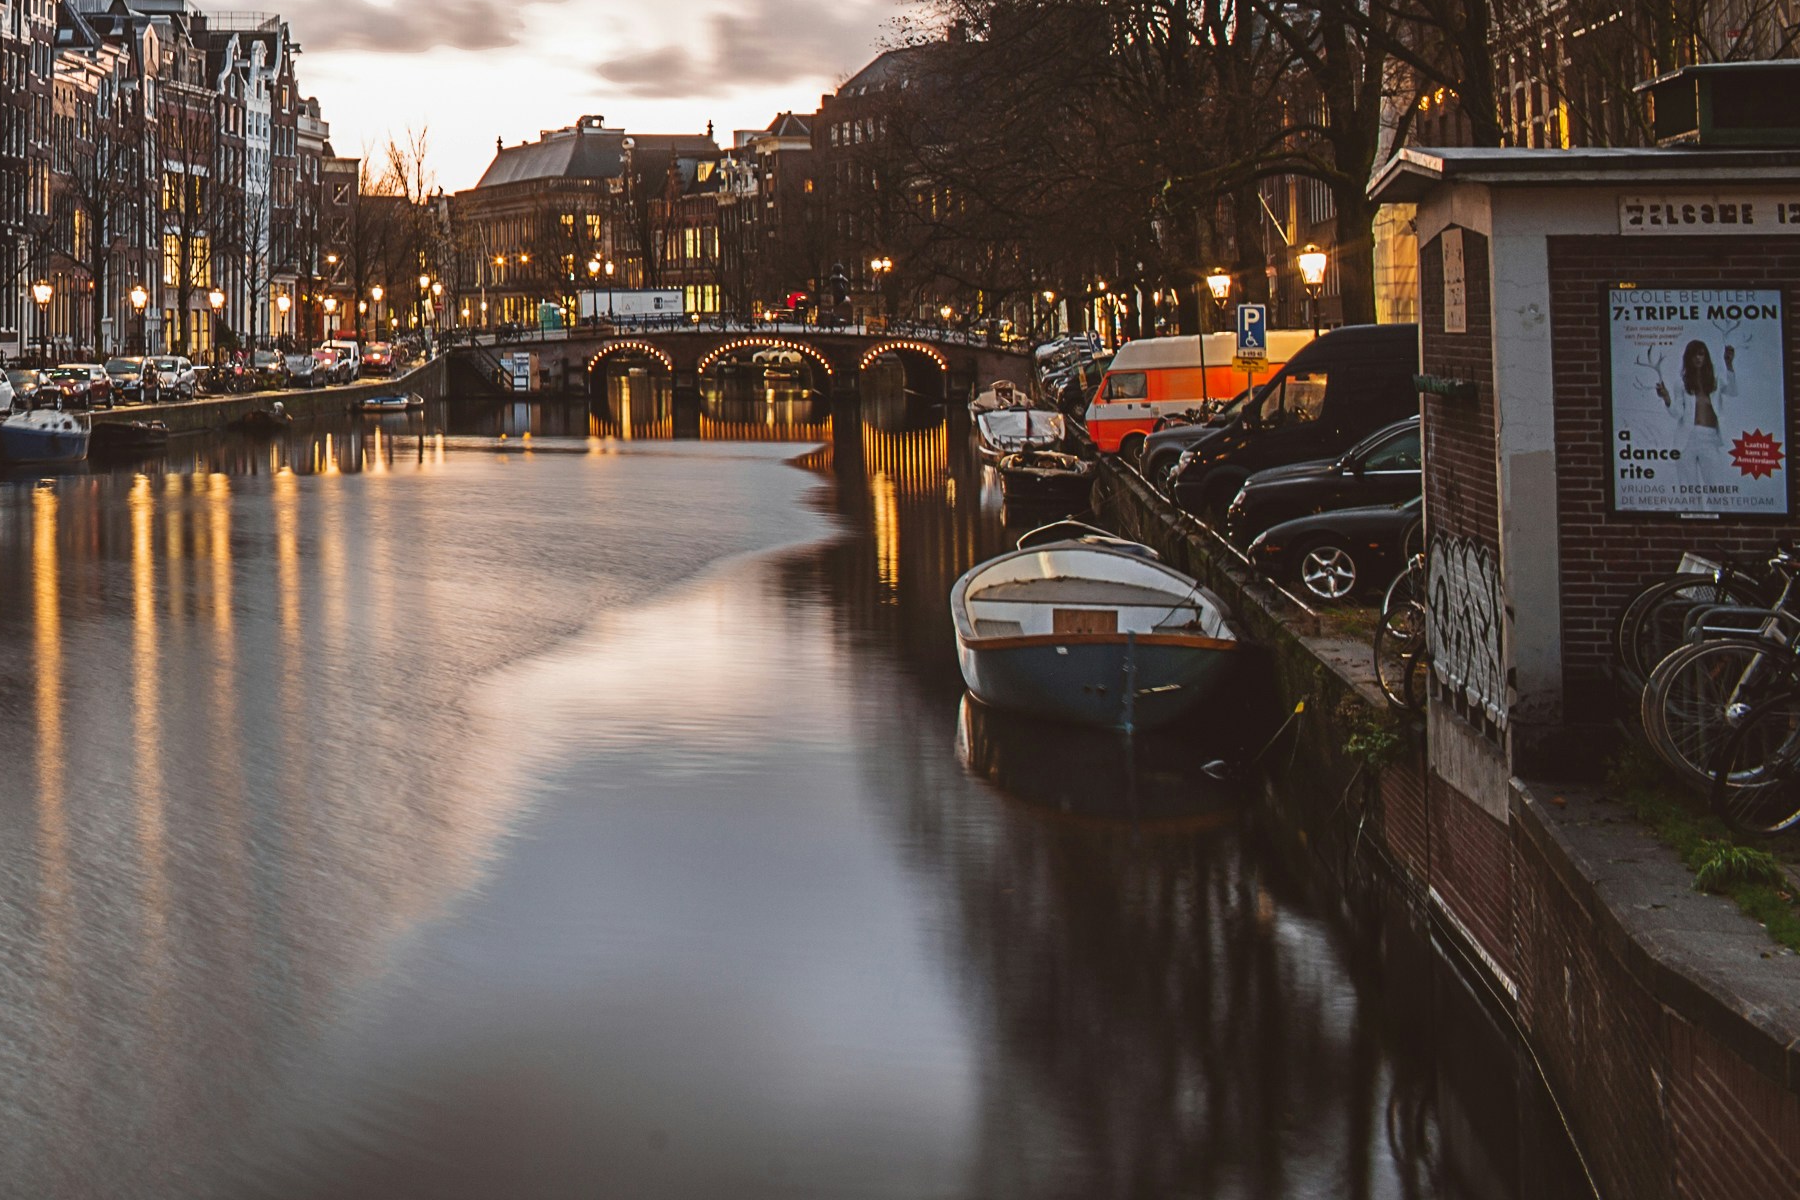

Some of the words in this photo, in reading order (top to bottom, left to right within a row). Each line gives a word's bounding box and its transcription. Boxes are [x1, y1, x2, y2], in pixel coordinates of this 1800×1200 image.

[1611, 291, 1672, 304] NICOLE
[1679, 290, 1756, 303] BEUTLER
[1244, 308, 1260, 331] P
[1613, 306, 1630, 321] 7:
[1634, 306, 1699, 320] TRIPLE
[1707, 305, 1777, 320] MOON
[1618, 430, 1630, 441] a
[1619, 444, 1681, 460] dance
[1620, 464, 1655, 479] rite
[1620, 485, 1665, 494] VRIJDAG
[1671, 485, 1676, 493] 1
[1680, 485, 1739, 494] DECEMBER
[1621, 496, 1634, 505] DE
[1638, 496, 1703, 506] MEERVAART
[1706, 497, 1774, 506] AMSTERDAM
